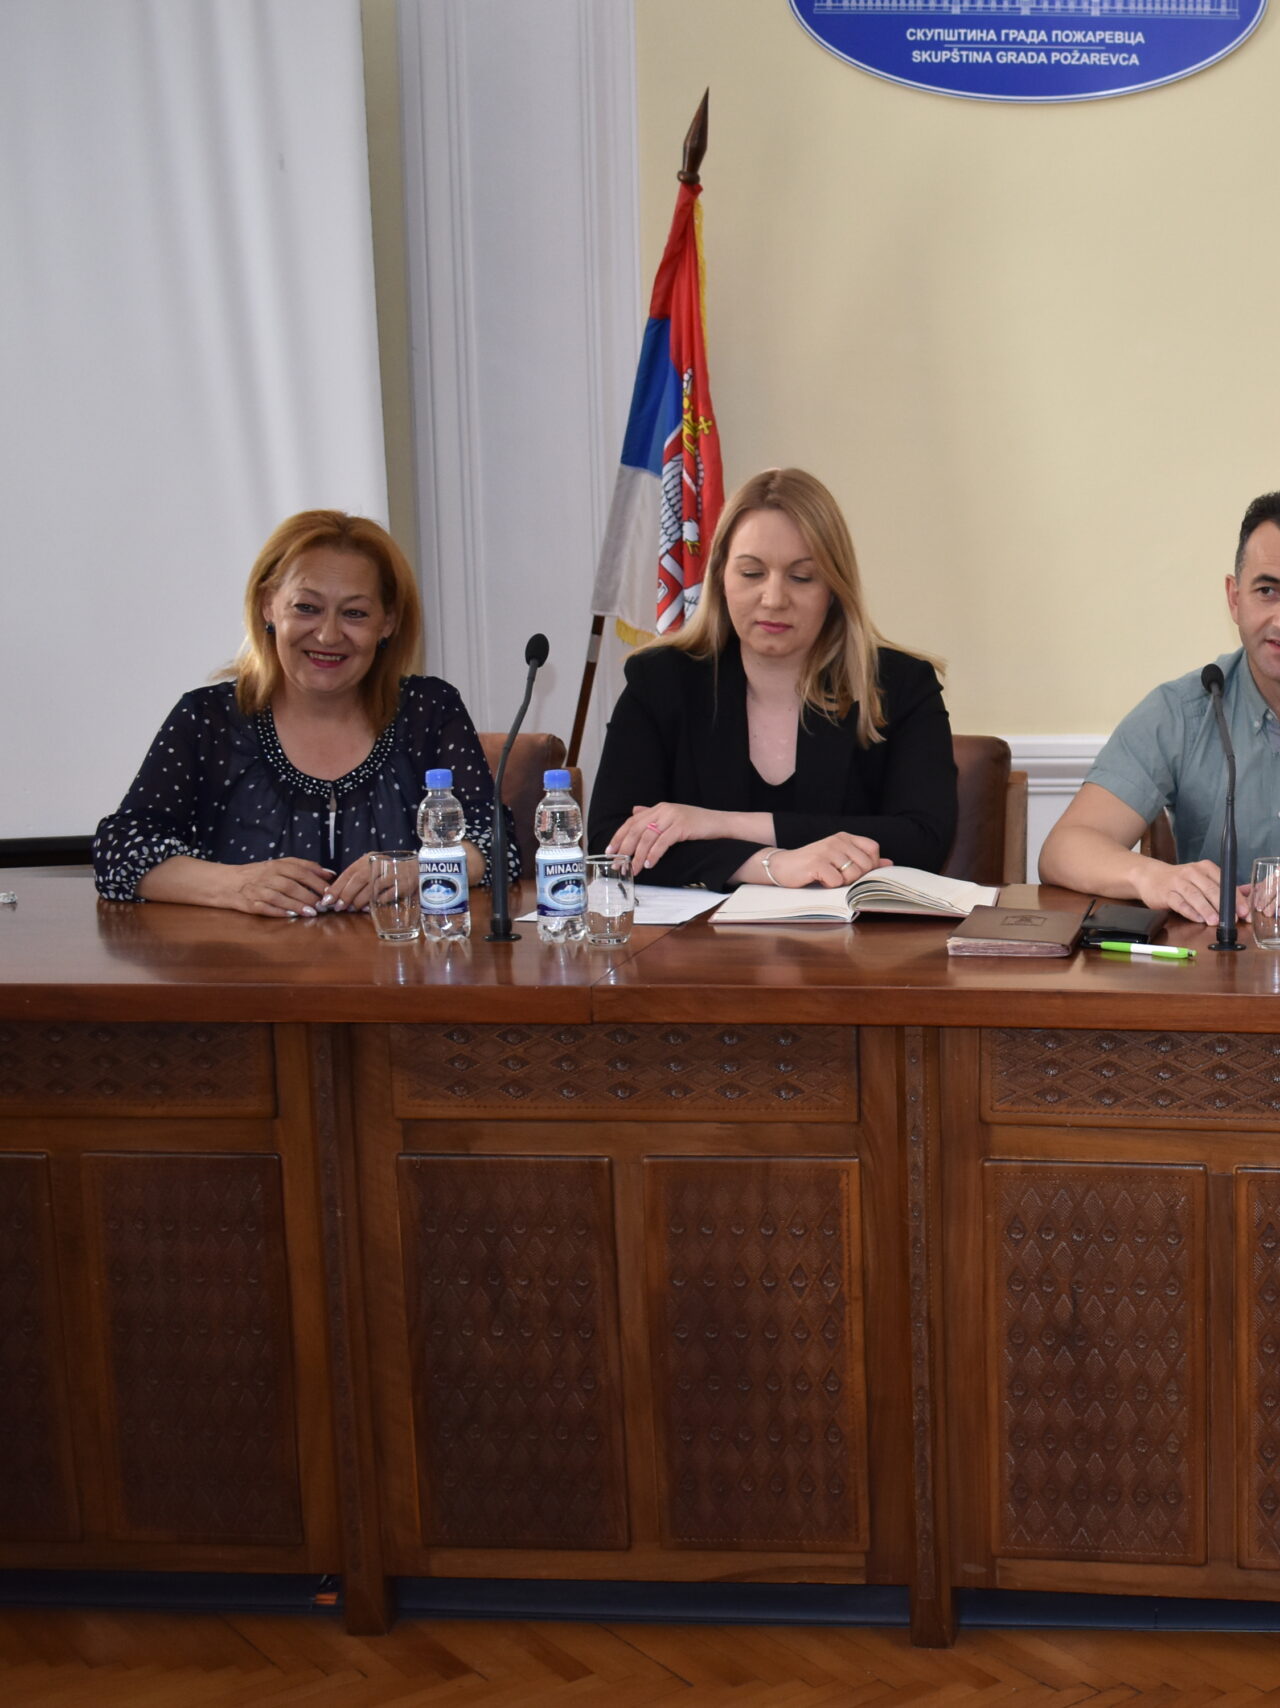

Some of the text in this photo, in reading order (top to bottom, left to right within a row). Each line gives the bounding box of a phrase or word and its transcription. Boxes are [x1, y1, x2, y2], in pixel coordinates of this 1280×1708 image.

[906, 28, 1145, 45] СКУПШТИНА ГРАДА ПОЖАРЕВЦА
[912, 48, 1139, 65] SKUPŠTINA GRADA POŽAREVCA
[546, 862, 584, 876] MINAQU
